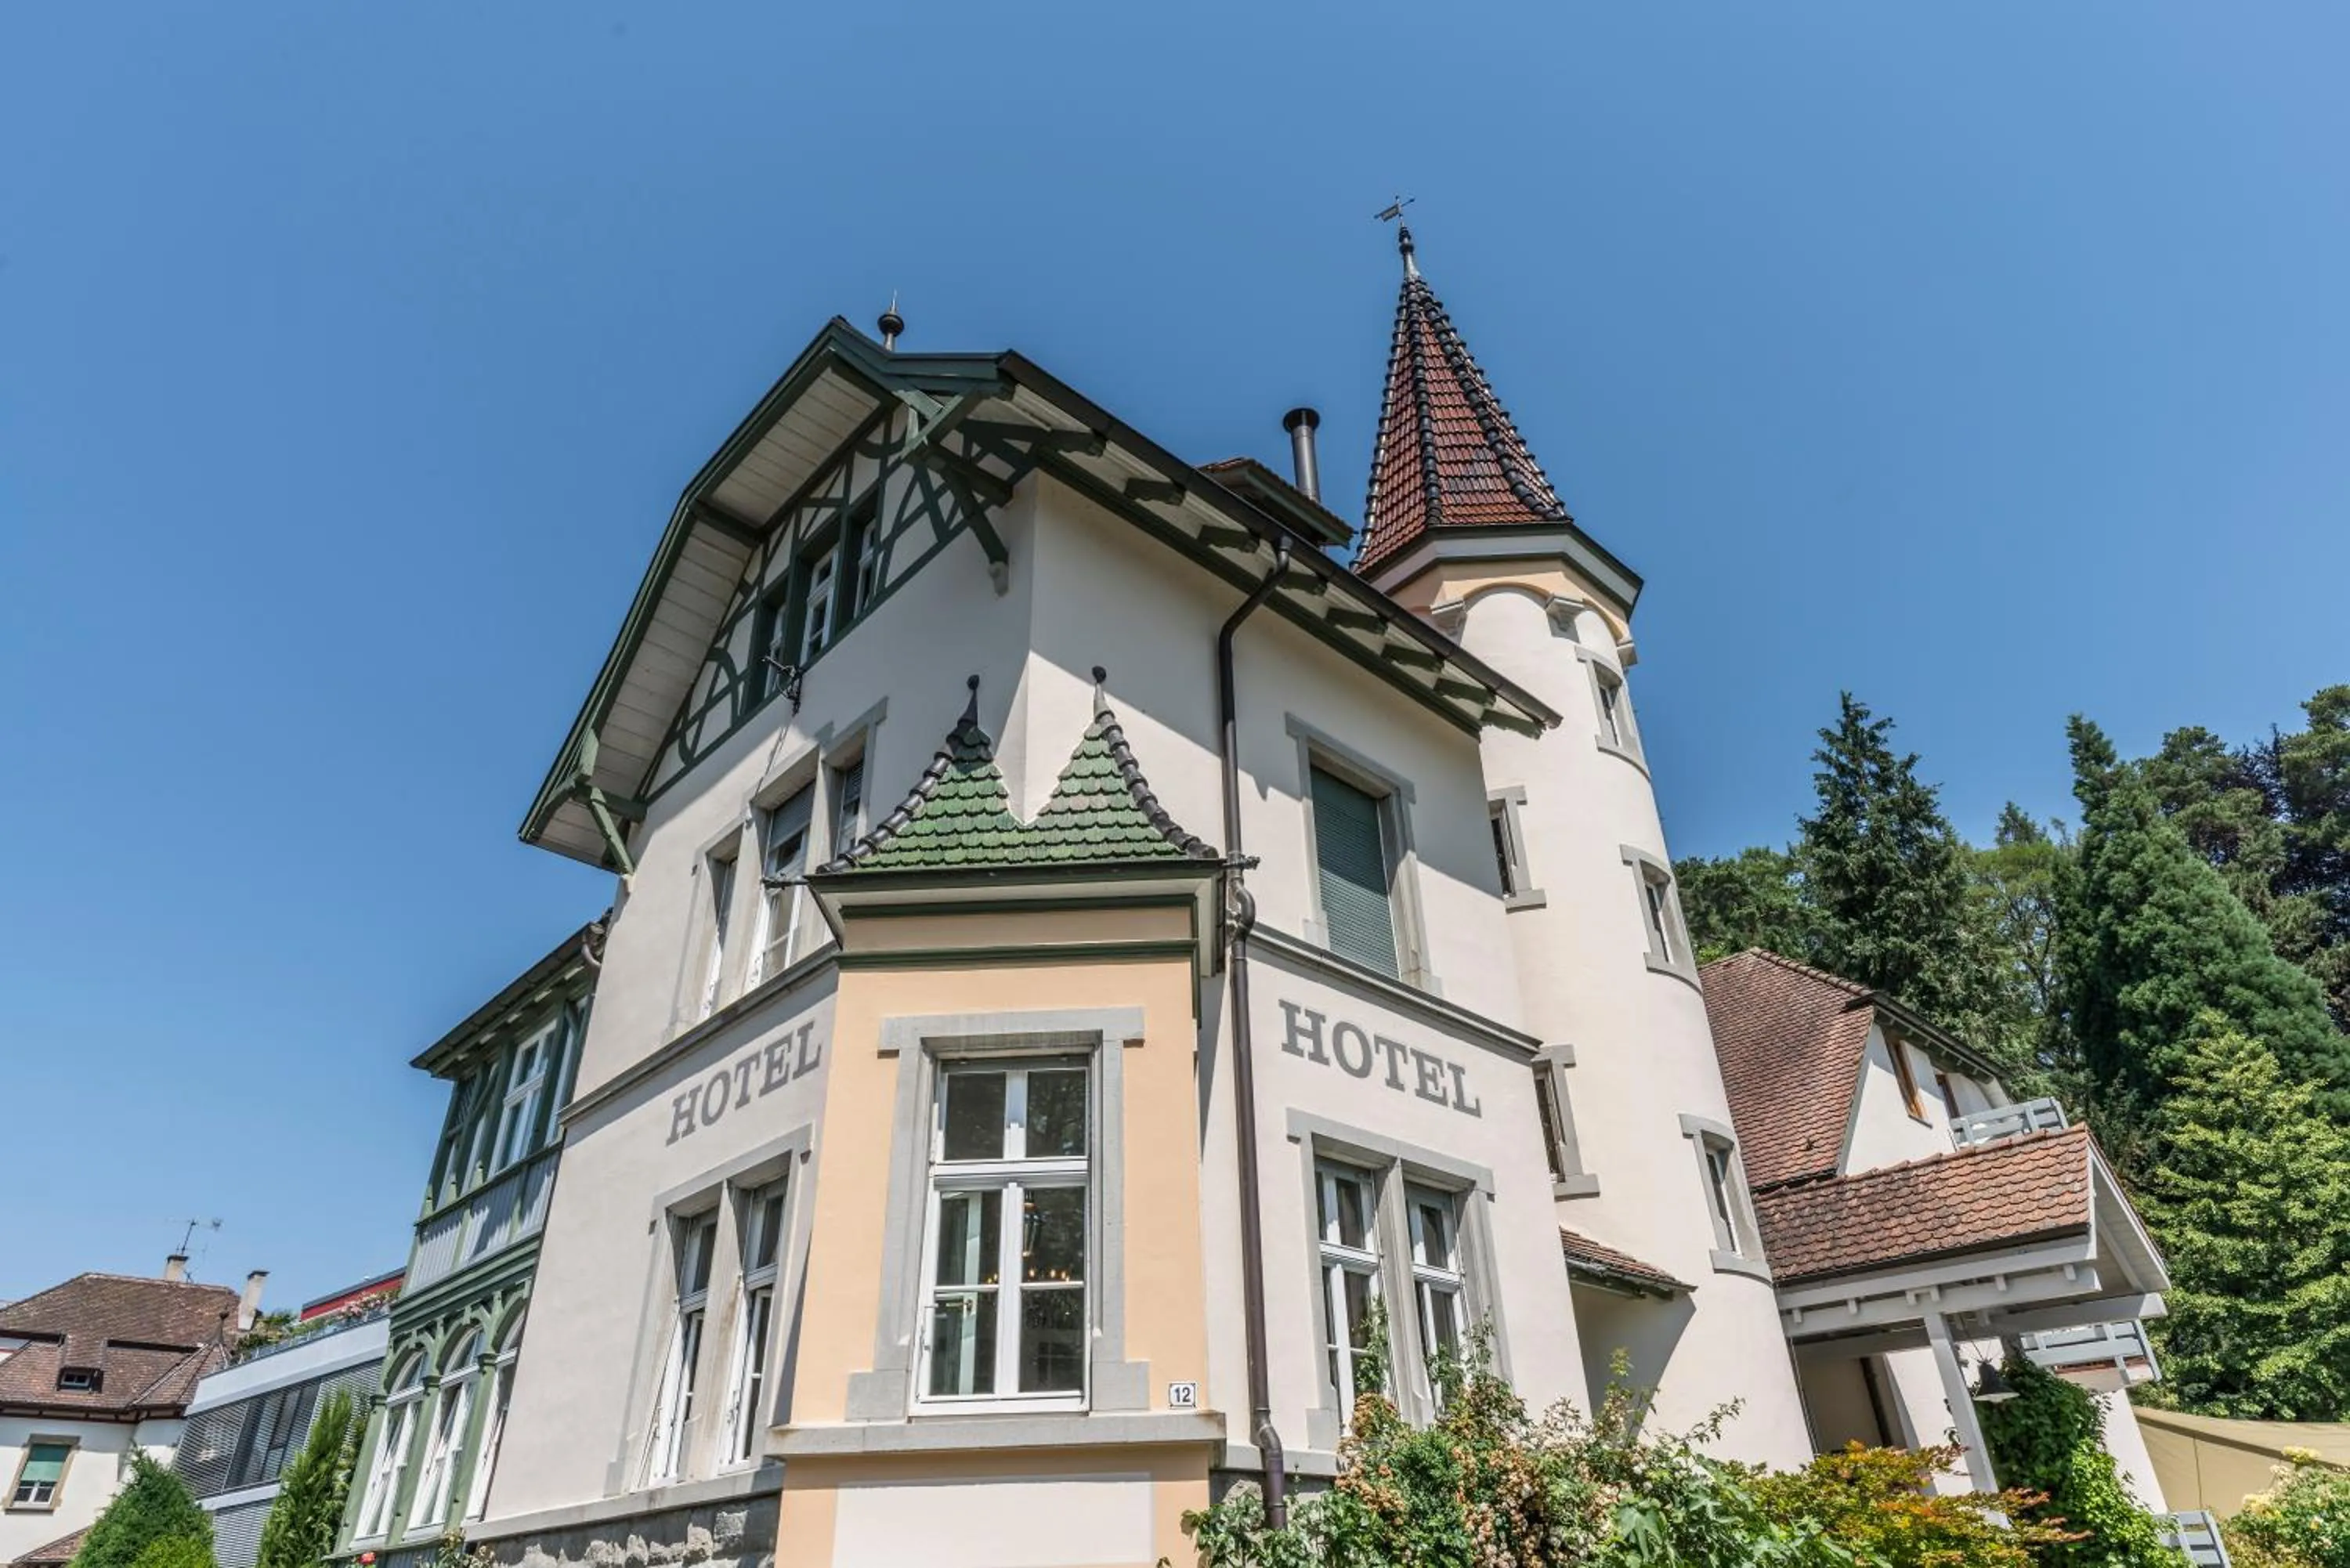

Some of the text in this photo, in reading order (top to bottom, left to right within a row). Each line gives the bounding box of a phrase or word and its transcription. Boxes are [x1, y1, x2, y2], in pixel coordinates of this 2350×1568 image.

[665, 1021, 822, 1147] HOTEL
[1278, 999, 1482, 1118] HOTEL
[1175, 1386, 1191, 1402] 12
